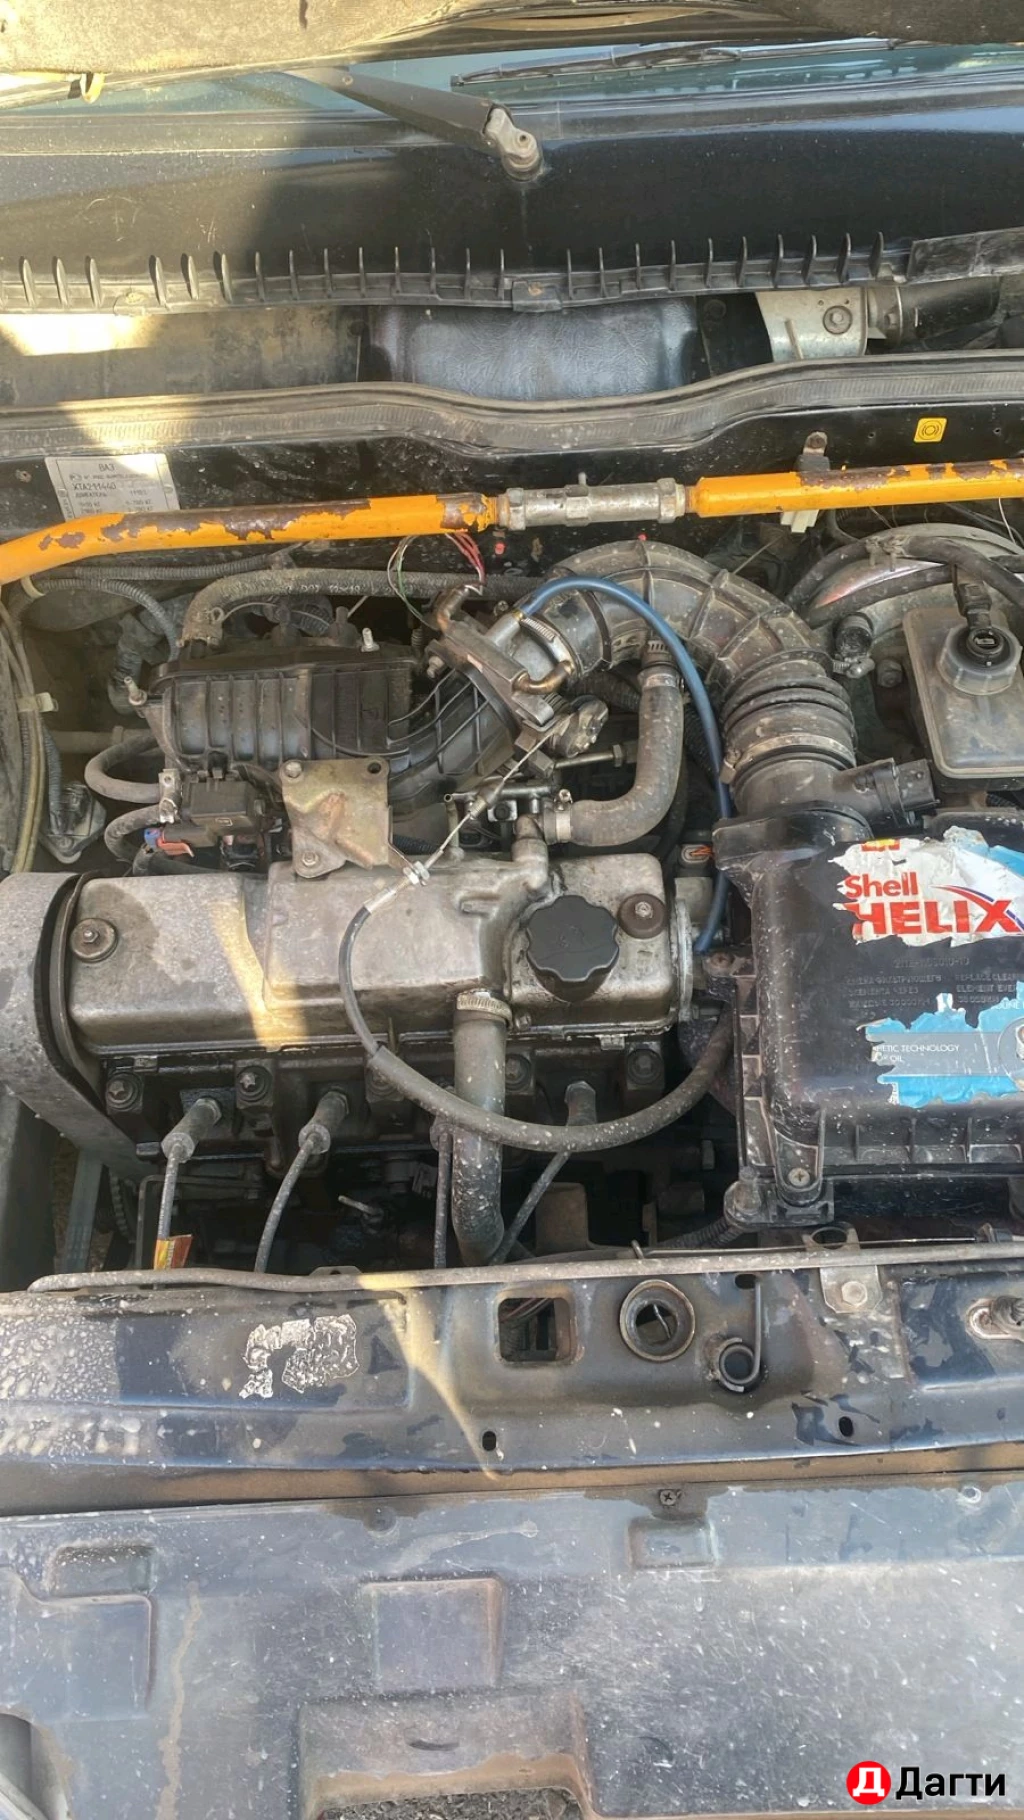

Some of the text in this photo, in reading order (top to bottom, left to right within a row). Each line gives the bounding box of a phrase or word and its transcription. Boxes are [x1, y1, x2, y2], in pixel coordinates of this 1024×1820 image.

[844, 871, 918, 898] Shell
[843, 900, 1020, 935] HELIX
[902, 1043, 960, 1052] TECHNOLOGY
